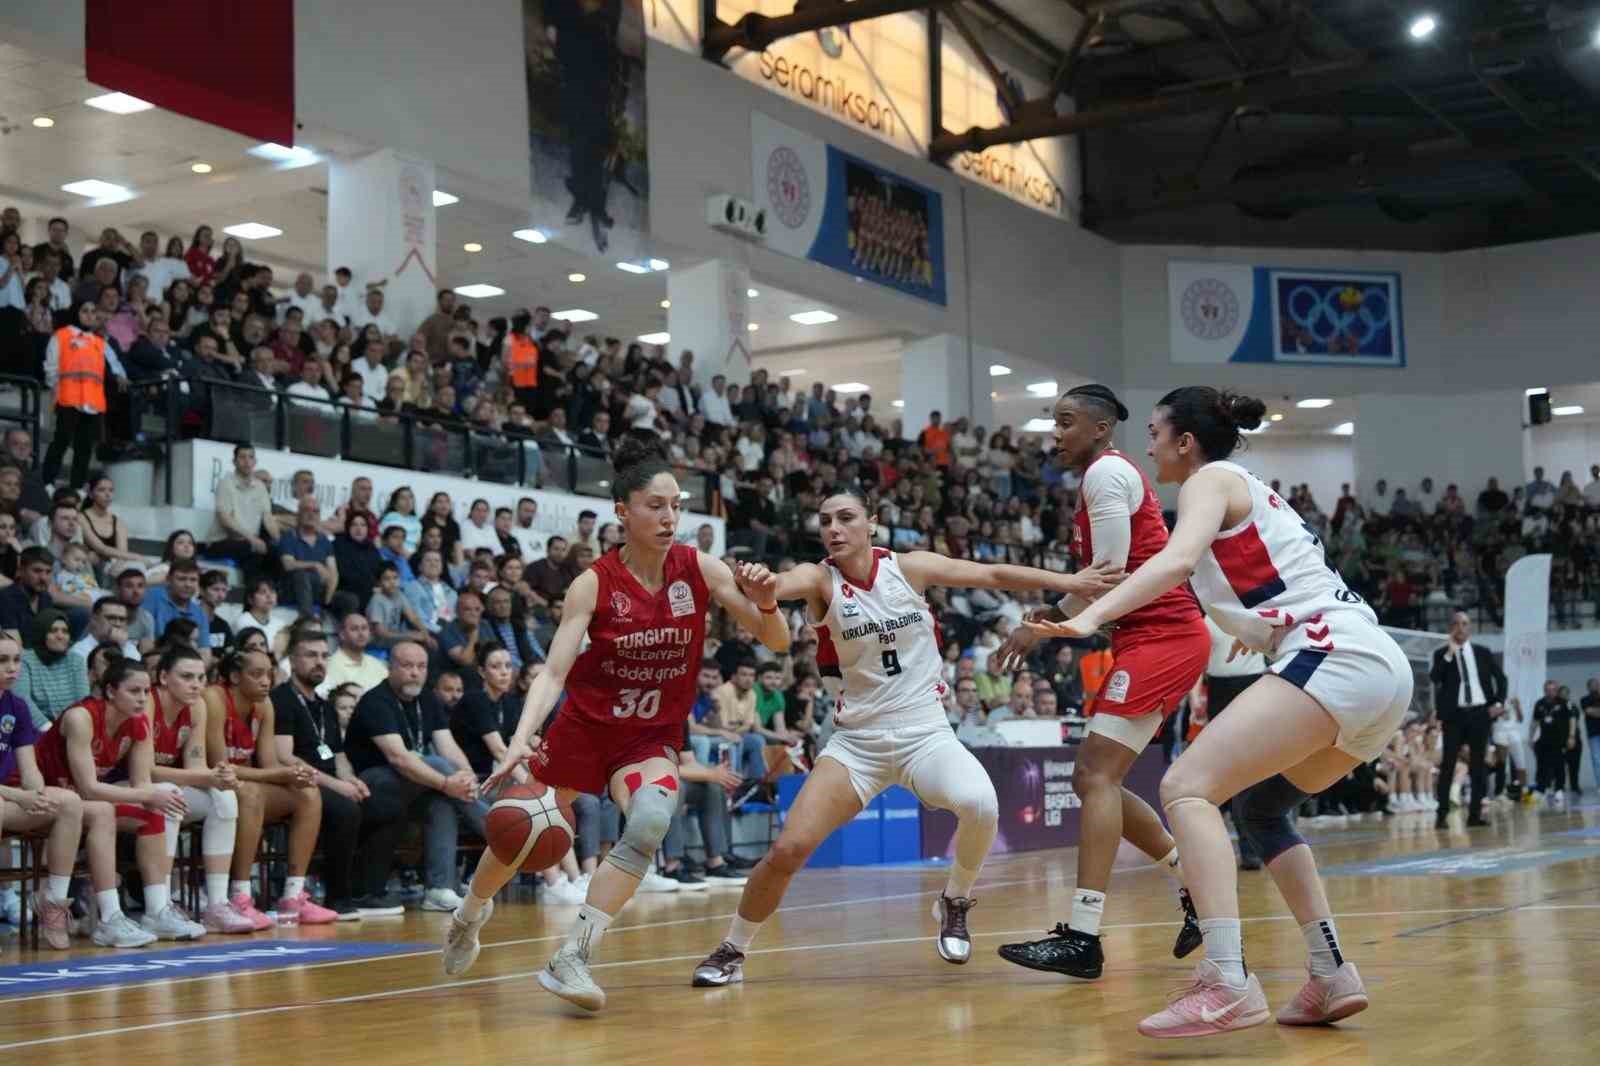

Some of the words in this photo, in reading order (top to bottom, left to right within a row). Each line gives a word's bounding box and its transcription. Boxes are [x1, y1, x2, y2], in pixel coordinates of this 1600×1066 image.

[614, 628, 692, 649] TURGUTLU
[881, 649, 902, 677] 9
[613, 688, 661, 719] 30
